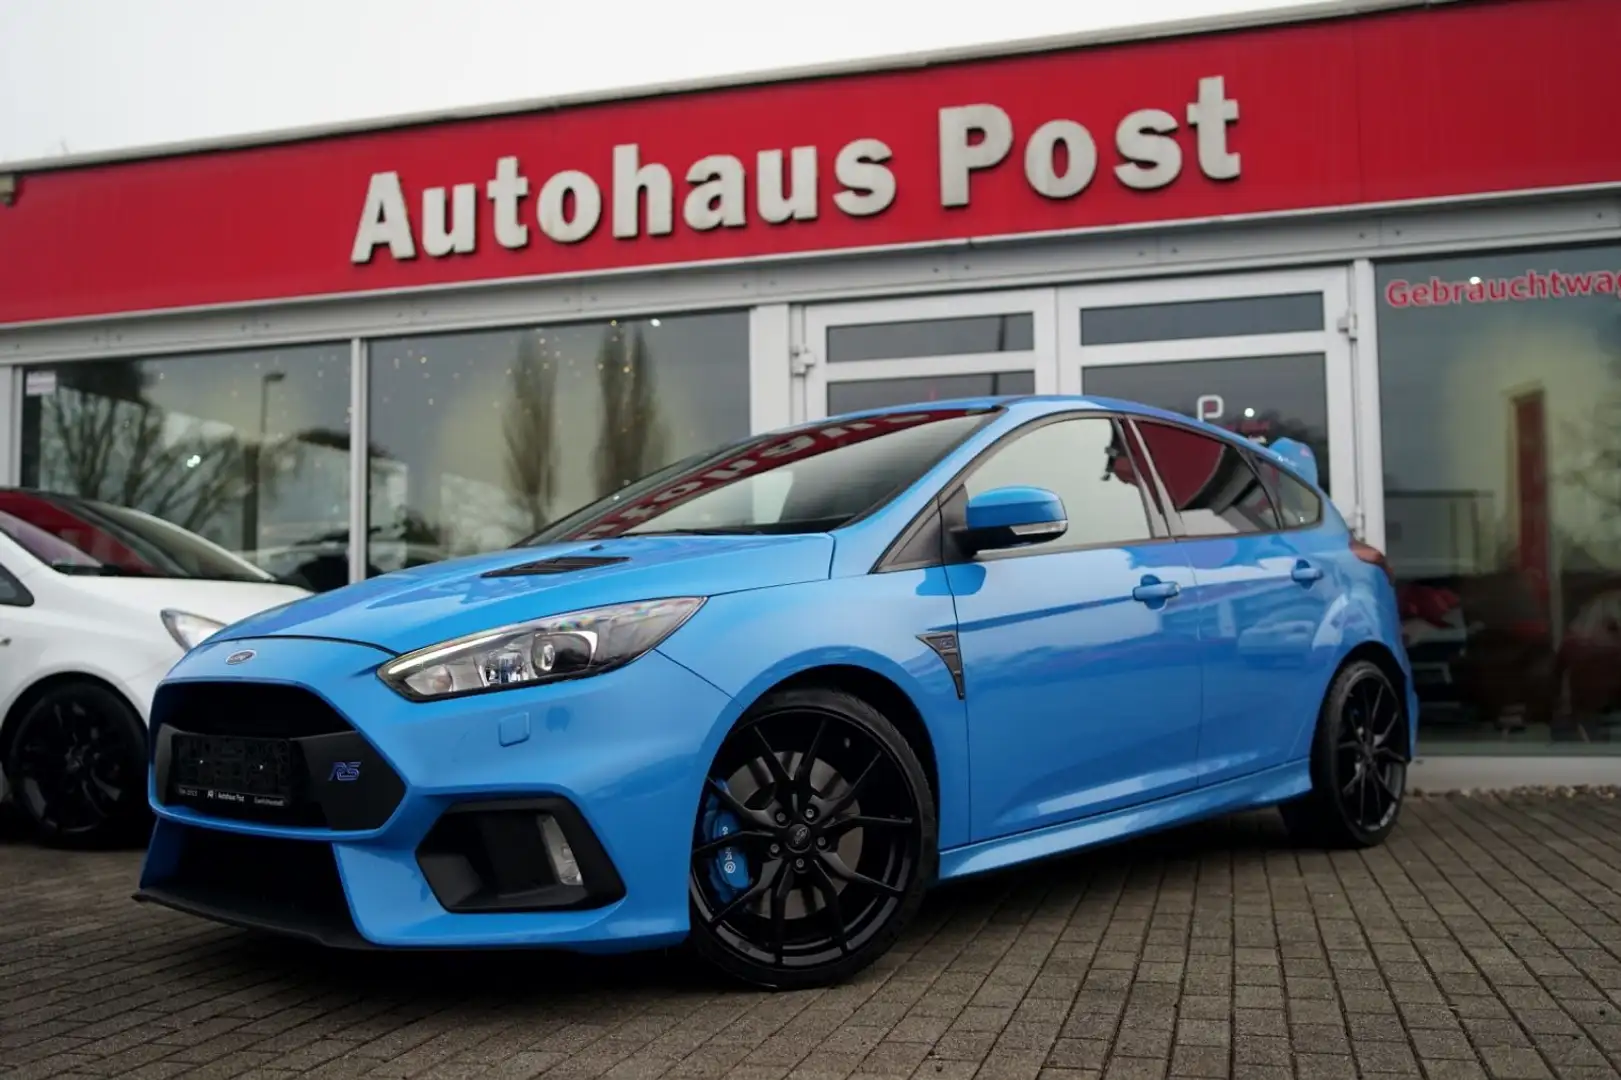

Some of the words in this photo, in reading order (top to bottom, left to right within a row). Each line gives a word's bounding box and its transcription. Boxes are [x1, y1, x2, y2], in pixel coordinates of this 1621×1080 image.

[351, 138, 897, 263] Autohaus
[939, 75, 1241, 207] Post
[1385, 268, 1621, 308] Gebrauchtwa
[328, 761, 361, 781] RS
